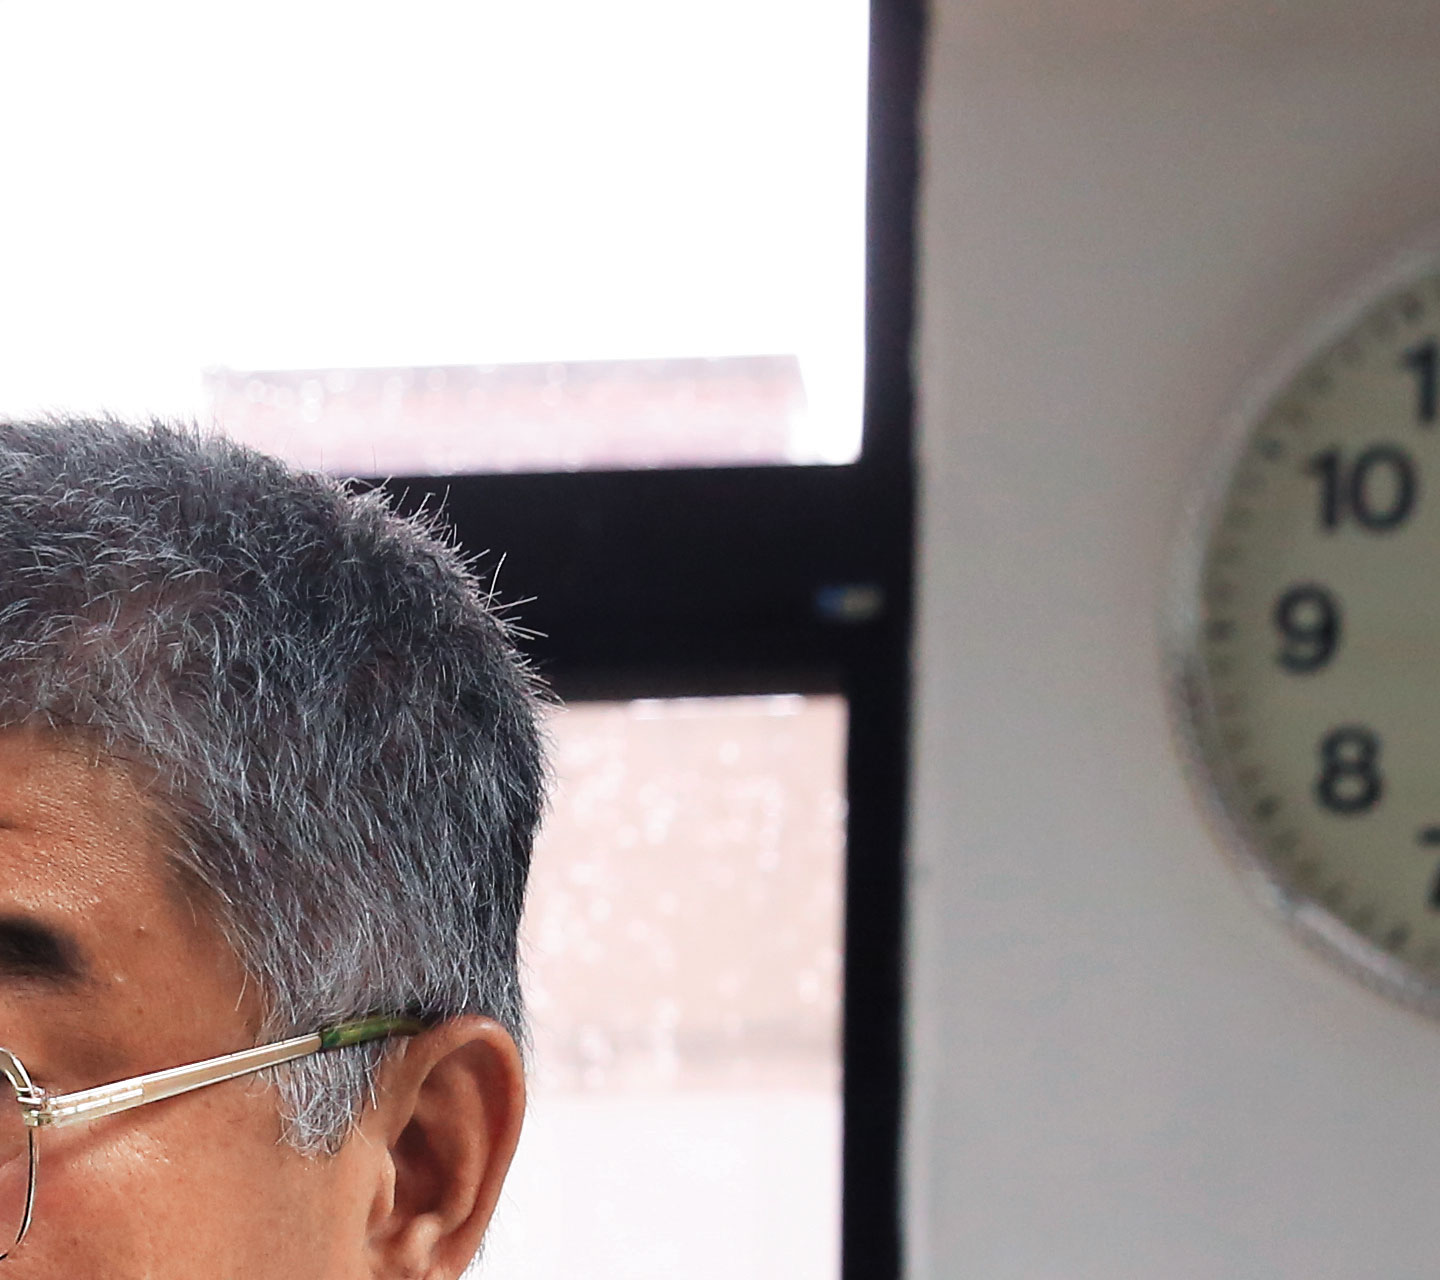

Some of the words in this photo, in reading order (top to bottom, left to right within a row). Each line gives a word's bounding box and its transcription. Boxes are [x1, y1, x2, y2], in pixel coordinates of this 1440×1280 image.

[1305, 445, 1419, 533] 10
[1273, 586, 1341, 673] 9
[1315, 728, 1384, 816] 8
